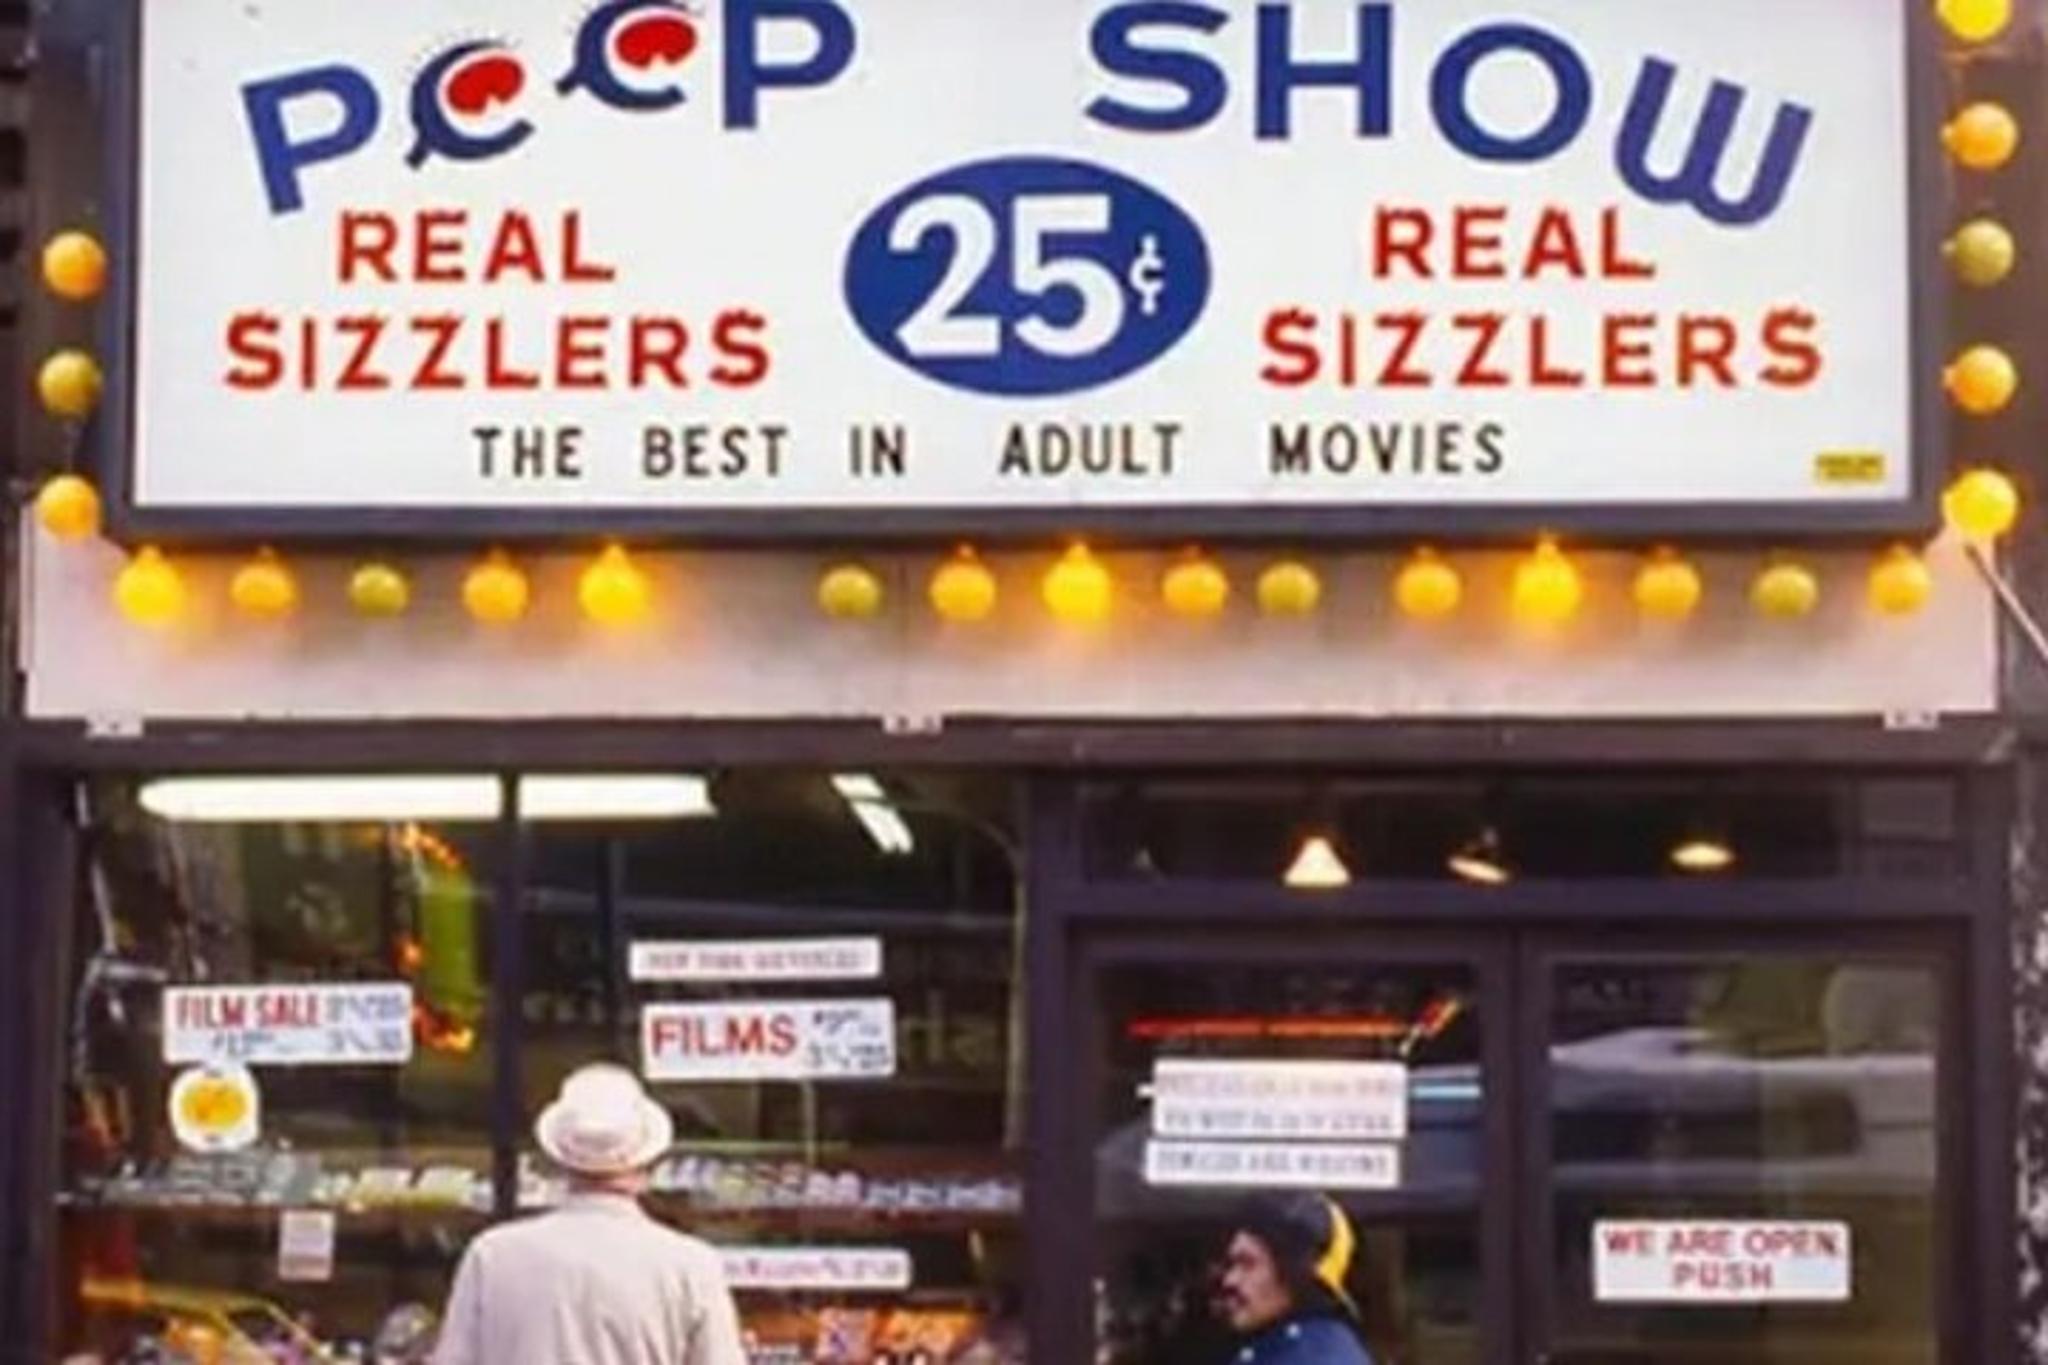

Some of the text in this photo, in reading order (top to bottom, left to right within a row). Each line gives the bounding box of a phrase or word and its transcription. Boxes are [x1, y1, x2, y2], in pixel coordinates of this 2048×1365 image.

[1084, 0, 1812, 226] SHOW
[337, 209, 614, 283] REAL
[1371, 205, 1656, 280] REAL
[888, 194, 1165, 357] 25¢
[473, 423, 1504, 478] THE BEST IN ADULT MOVIES
[176, 993, 246, 1029] FILM
[254, 991, 320, 1027] SALE
[651, 1012, 797, 1056] FILMS
[1604, 1228, 1838, 1256] WE ARE OPEN
[1673, 1261, 1774, 1290] PUSH
